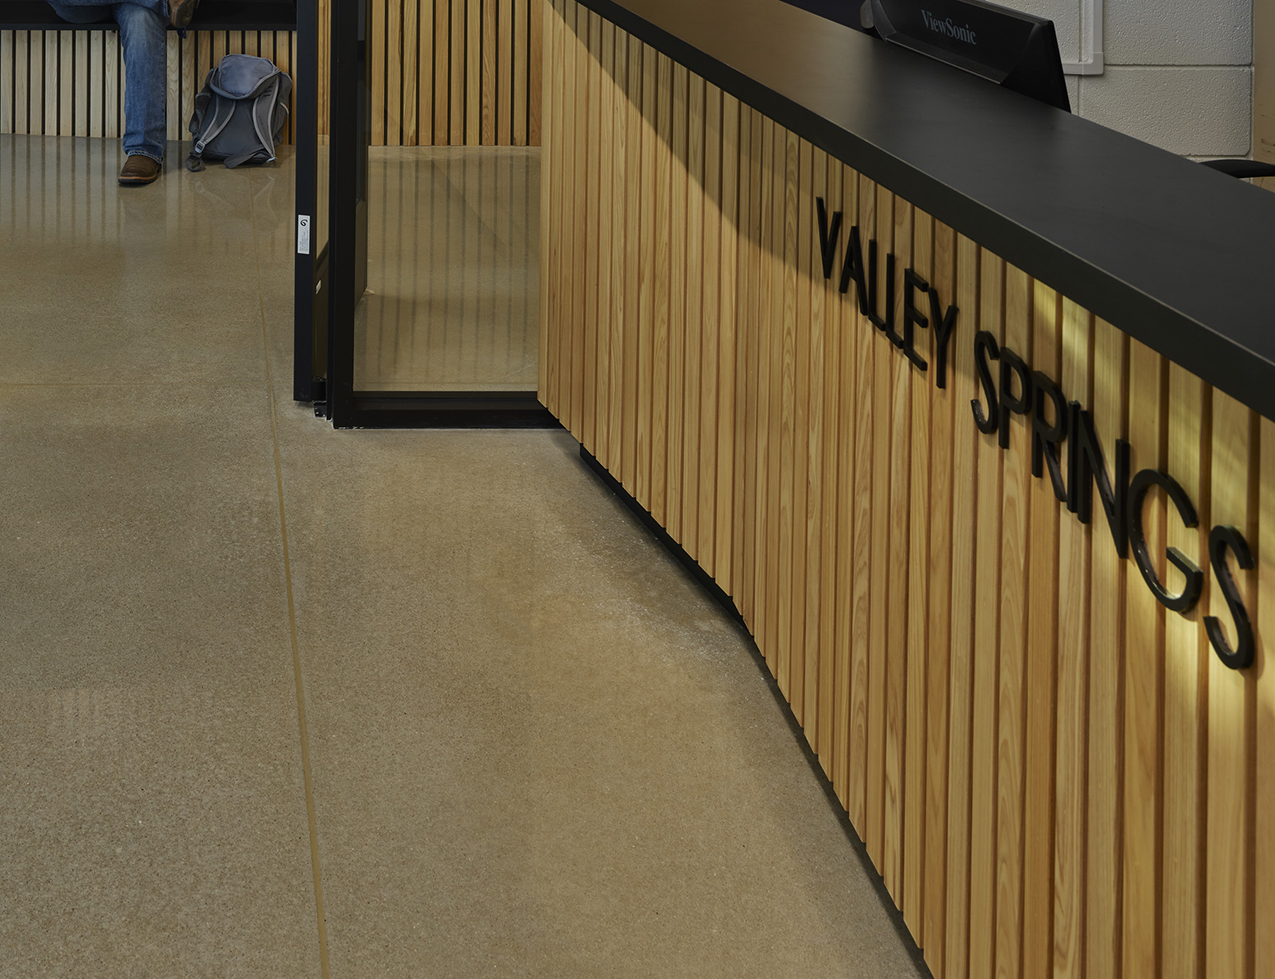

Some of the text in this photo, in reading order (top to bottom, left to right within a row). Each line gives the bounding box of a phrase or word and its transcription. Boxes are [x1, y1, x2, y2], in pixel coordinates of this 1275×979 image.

[921, 9, 977, 45] ViewSonic
[815, 196, 1255, 670] VALLEY SPRINGS
